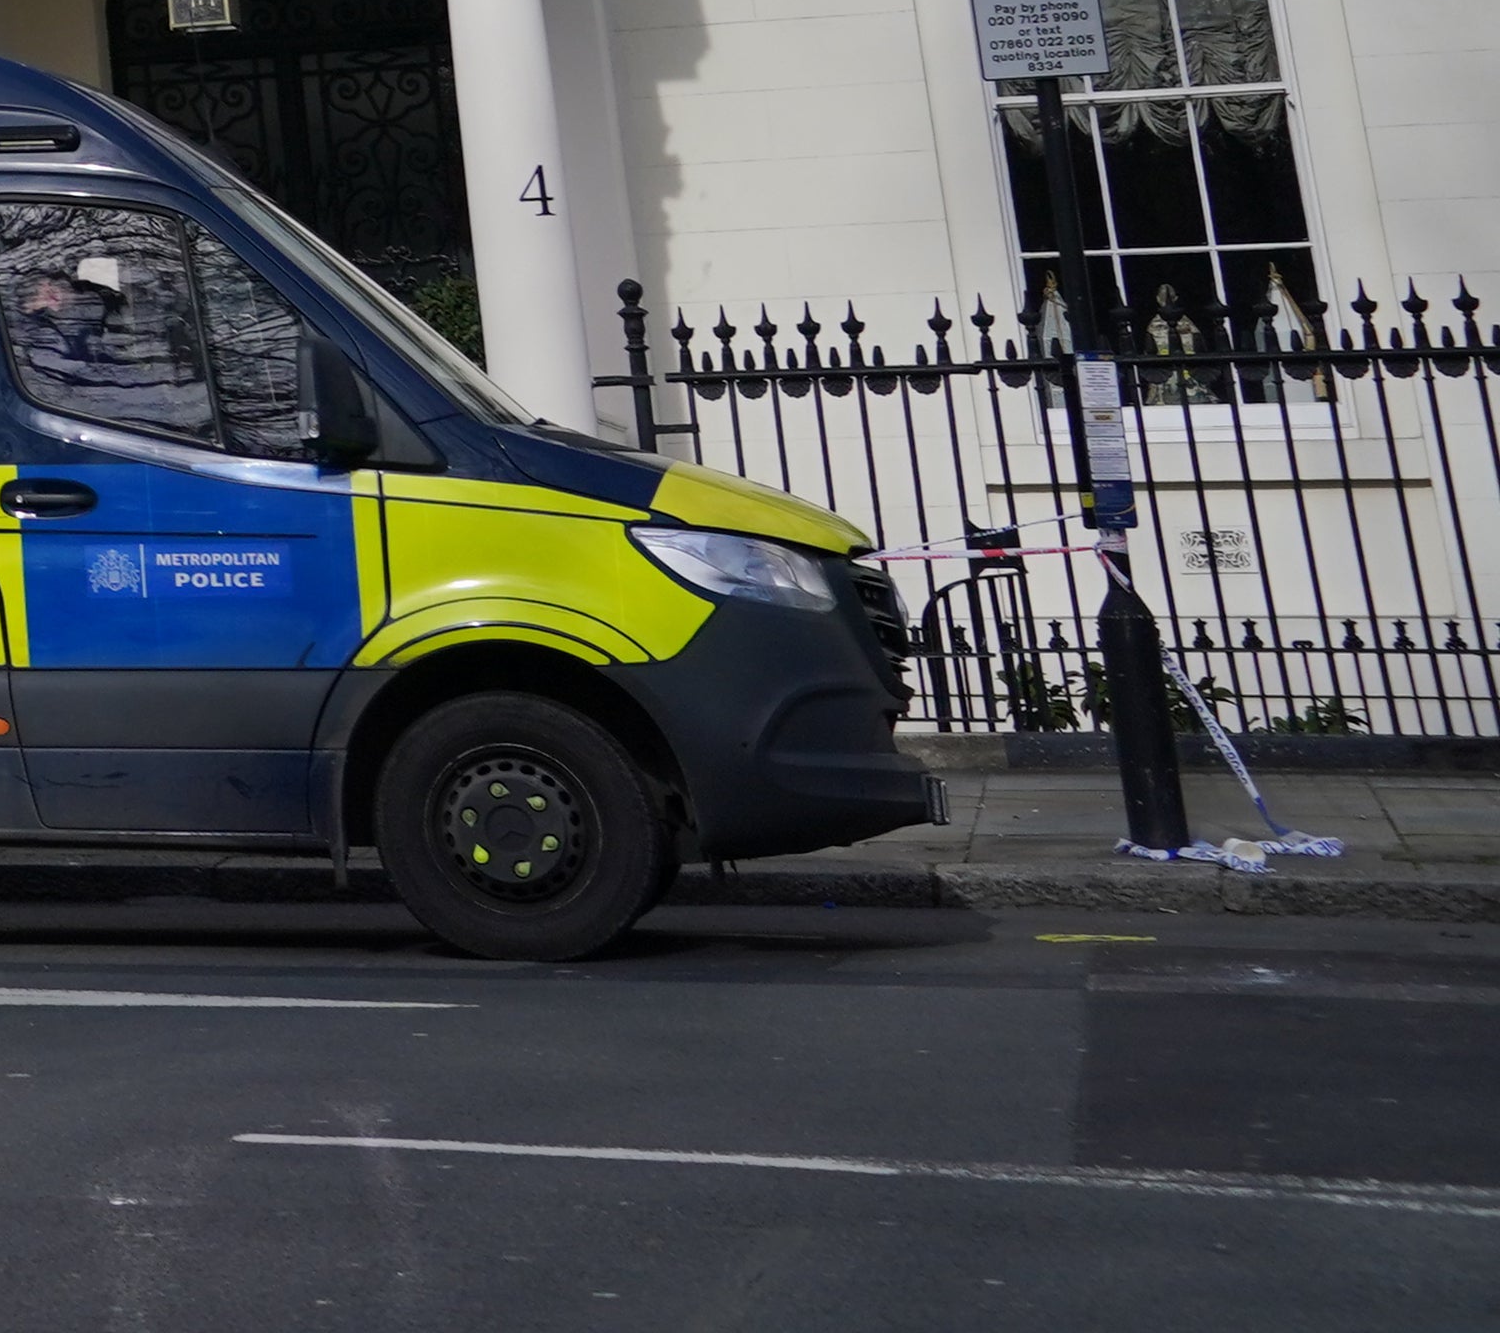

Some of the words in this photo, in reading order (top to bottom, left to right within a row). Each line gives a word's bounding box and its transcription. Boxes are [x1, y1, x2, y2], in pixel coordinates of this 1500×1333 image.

[994, 4, 1017, 15] Pay
[1021, 3, 1036, 13] by
[1040, 1, 1079, 12] phone
[987, 15, 1014, 26] 020
[1020, 13, 1049, 24] 7125
[1053, 11, 1089, 22] 9090
[1018, 28, 1031, 36] or
[1036, 25, 1062, 35] text
[990, 39, 1033, 50] 07860
[1038, 37, 1063, 48] 022
[1067, 35, 1095, 45] 205
[991, 51, 1040, 63] quoting
[1044, 48, 1096, 59] location
[1028, 61, 1064, 71] 8334
[519, 164, 556, 216] 4
[155, 552, 280, 566] METROPOLITAN
[174, 572, 265, 588] POLICE
